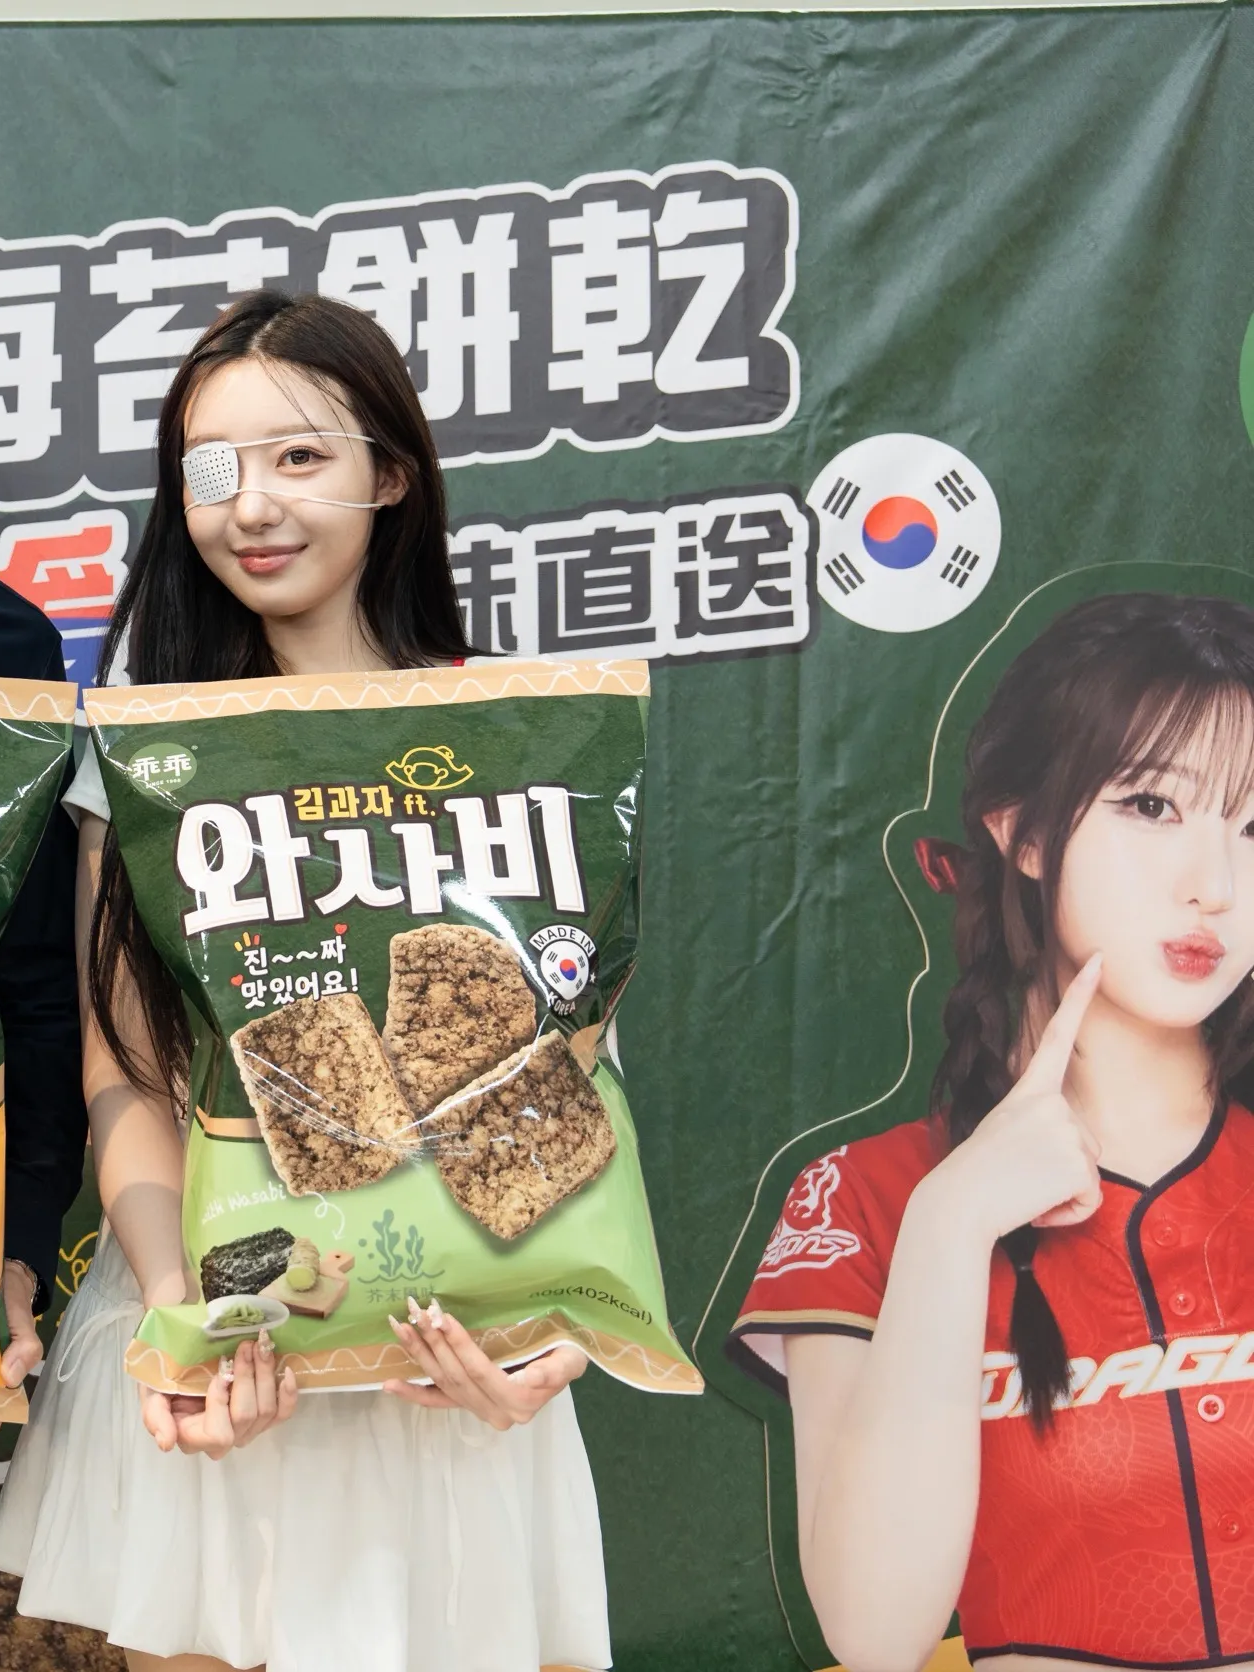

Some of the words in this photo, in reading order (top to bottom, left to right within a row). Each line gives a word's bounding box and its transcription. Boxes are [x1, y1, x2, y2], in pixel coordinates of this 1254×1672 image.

[129, 753, 192, 781] 乖乖
[294, 785, 394, 822] 김과자
[403, 792, 437, 817] ft.
[176, 786, 586, 936] 와사비
[532, 927, 577, 948] MADE
[579, 935, 595, 955] IN
[240, 967, 359, 1010] 맛있어요!
[548, 991, 577, 1016] KOREA
